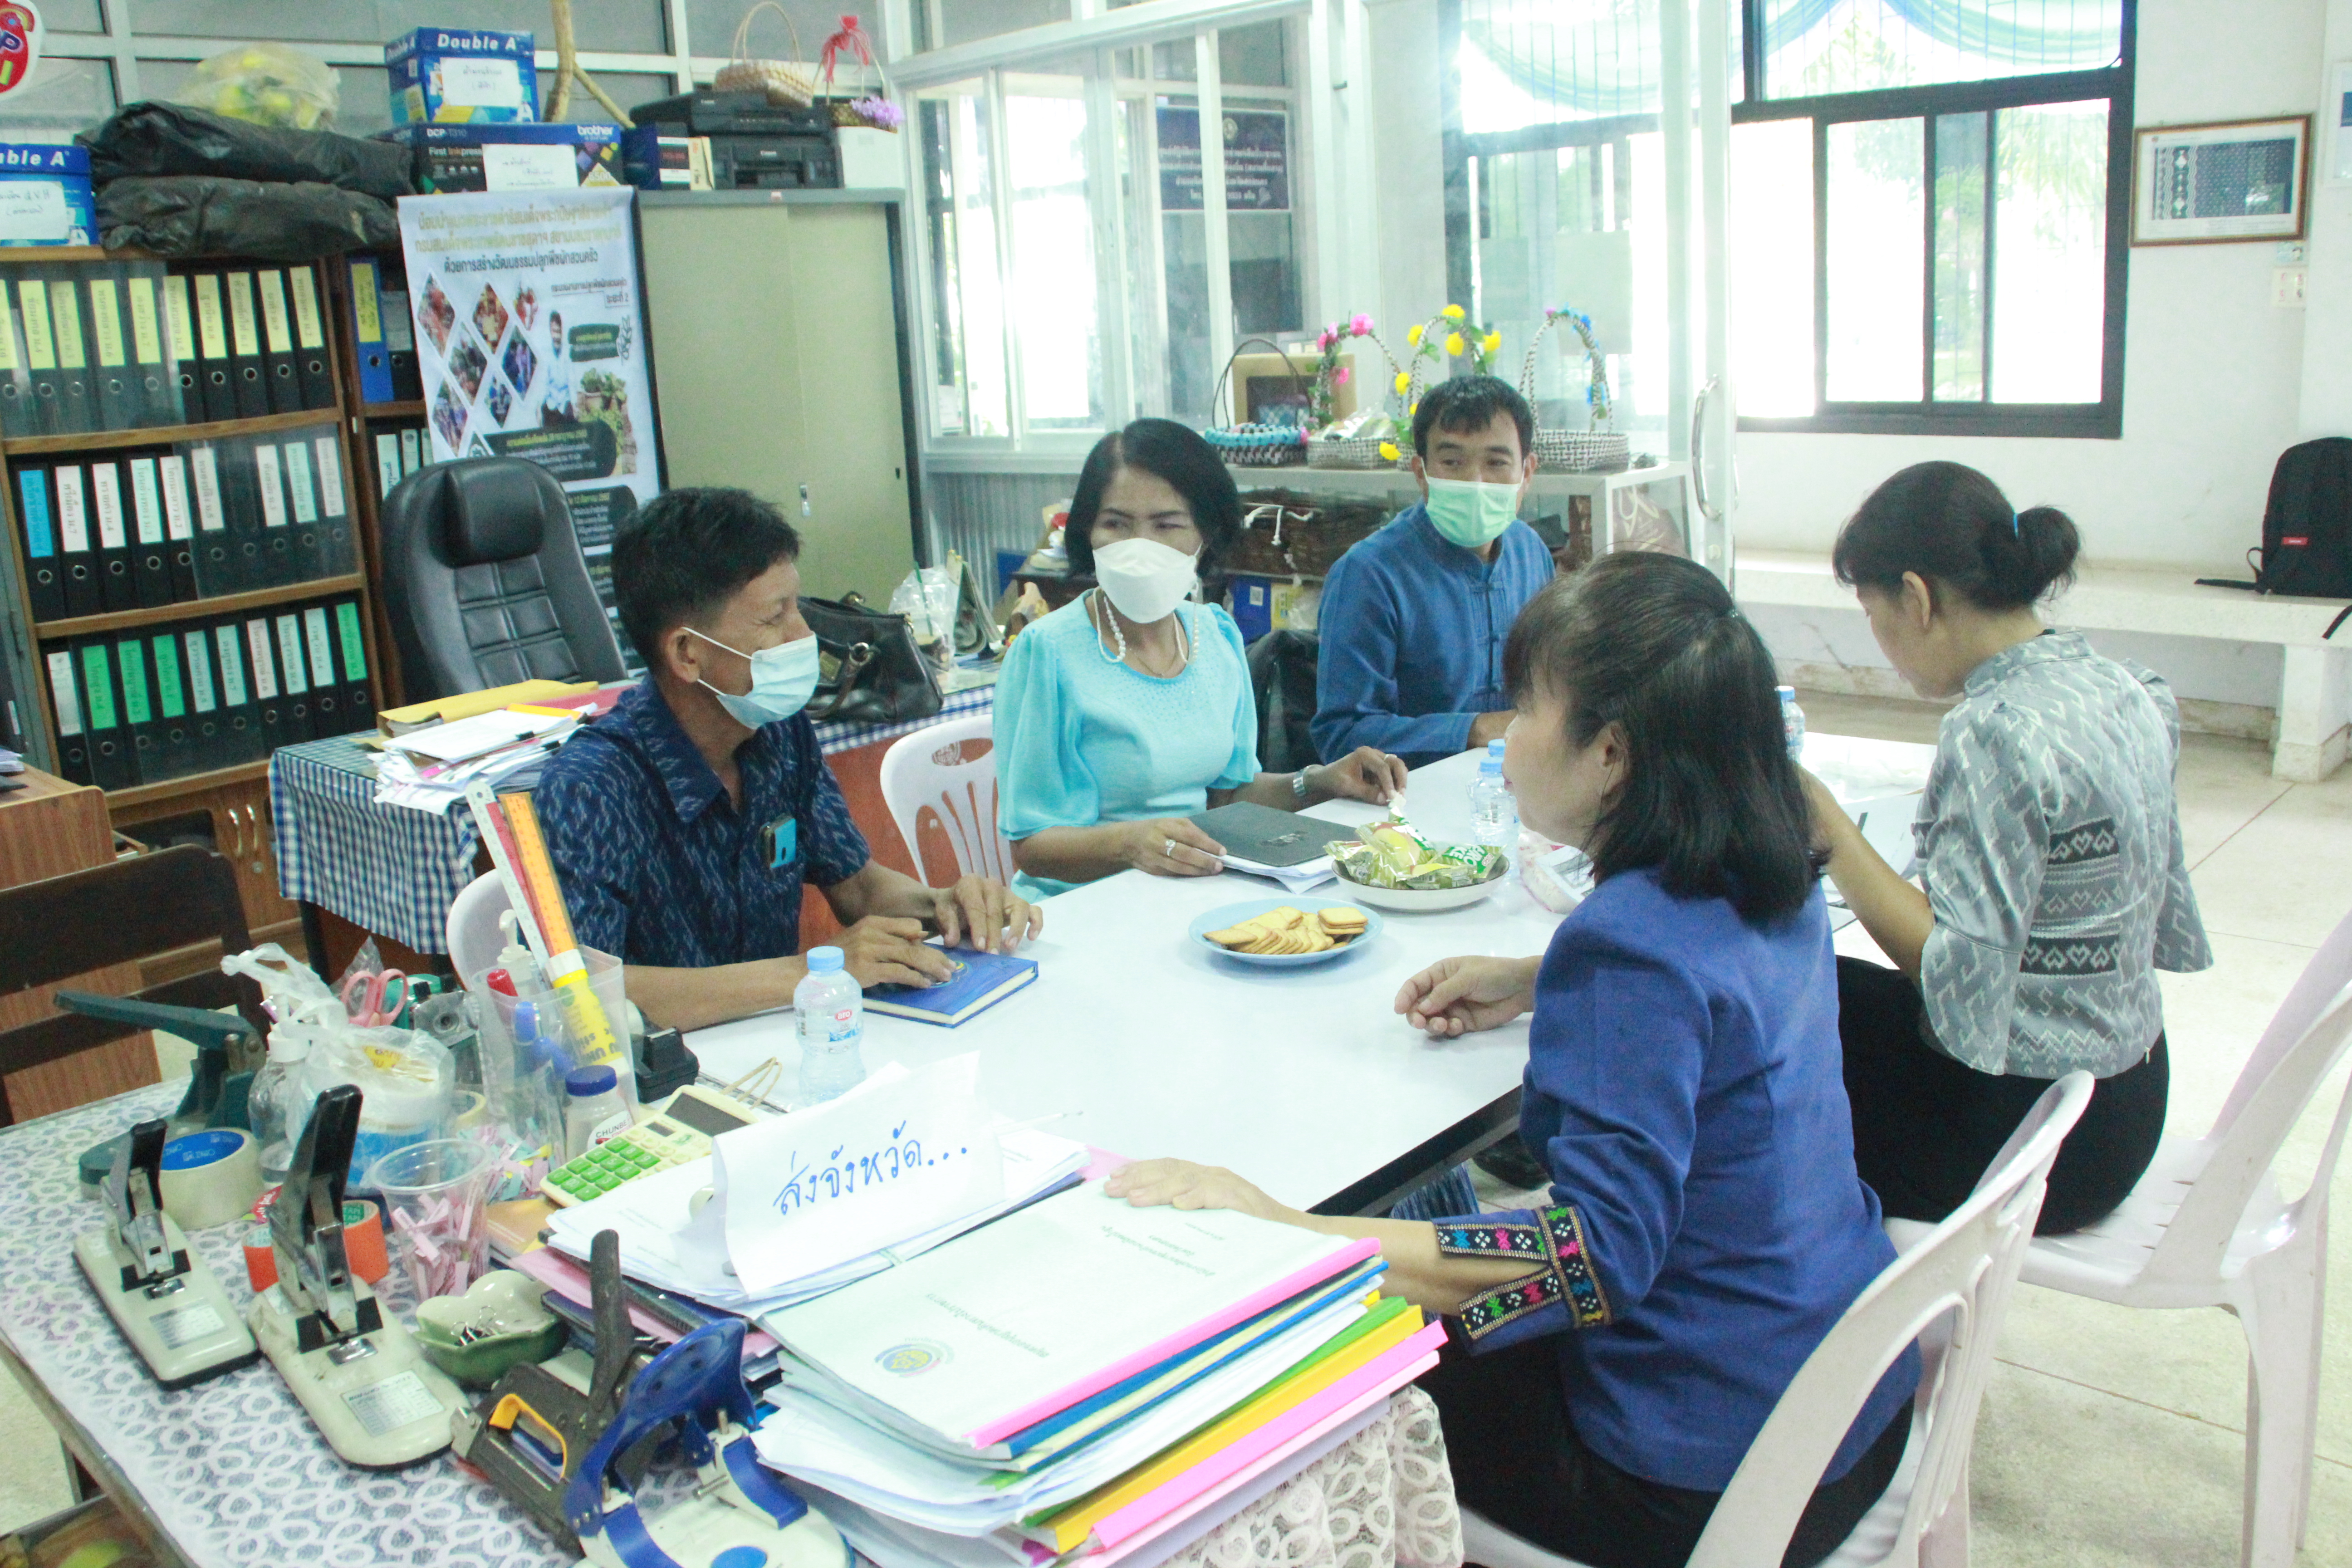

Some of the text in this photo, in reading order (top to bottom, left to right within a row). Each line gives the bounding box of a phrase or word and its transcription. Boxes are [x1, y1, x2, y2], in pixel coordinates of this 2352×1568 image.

[437, 34, 517, 50] Double A
[577, 125, 614, 137] brother
[50, 151, 66, 167] A
[837, 1011, 851, 1019] aro
[772, 1119, 968, 1215] ส่งจังหวัด...
